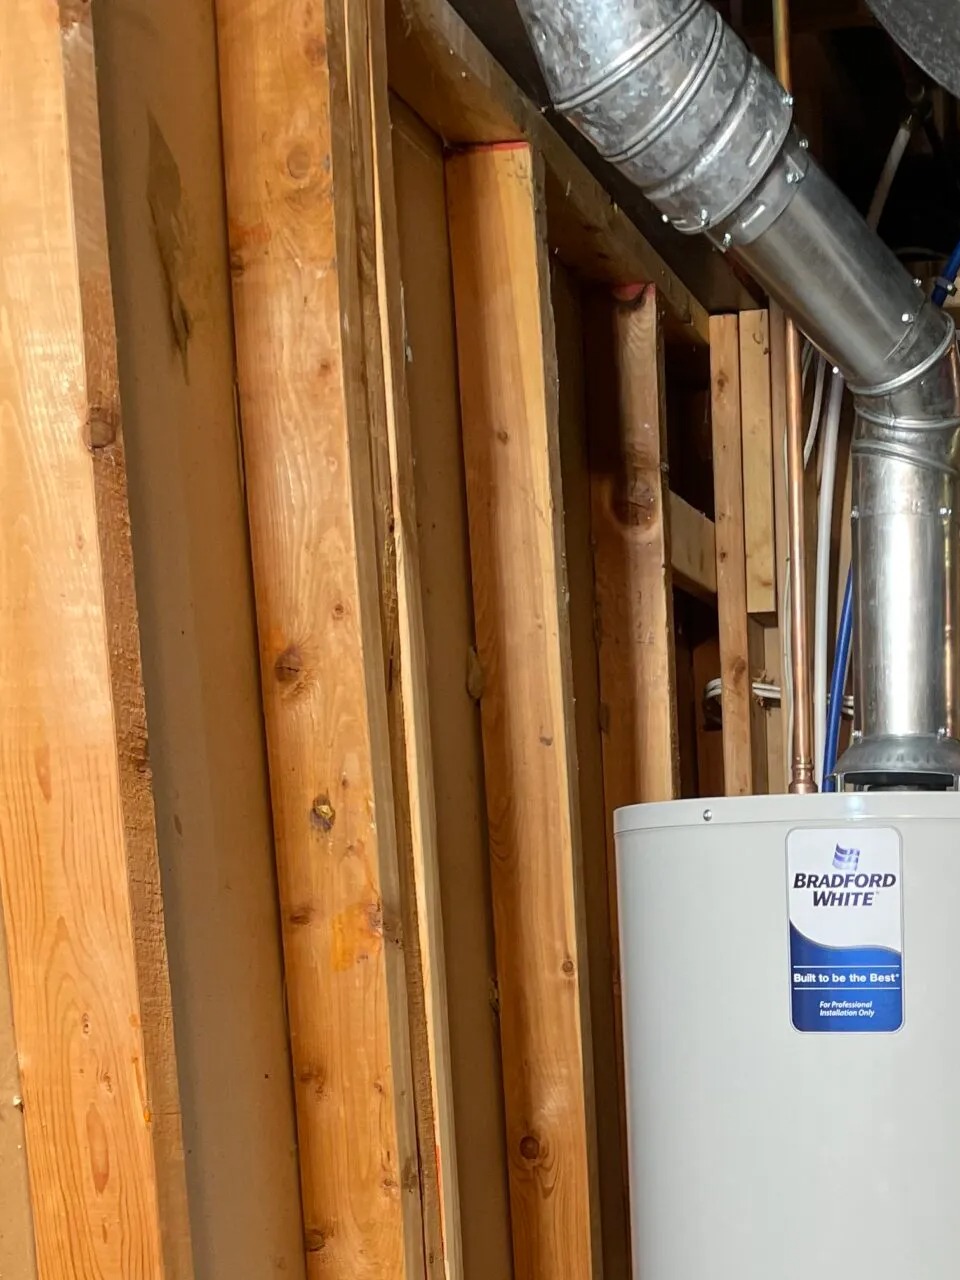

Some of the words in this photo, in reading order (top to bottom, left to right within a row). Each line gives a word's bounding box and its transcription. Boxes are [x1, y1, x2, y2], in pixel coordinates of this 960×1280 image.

[793, 873, 897, 889] BRADFORD
[813, 891, 874, 907] WHITE
[793, 973, 816, 983] Built
[818, 974, 829, 983] to
[832, 973, 846, 983] be
[849, 973, 867, 983] the
[820, 1001, 831, 1009] For
[832, 1001, 873, 1009] Professional
[820, 1009, 857, 1017] Installation
[859, 1009, 875, 1018] Only
